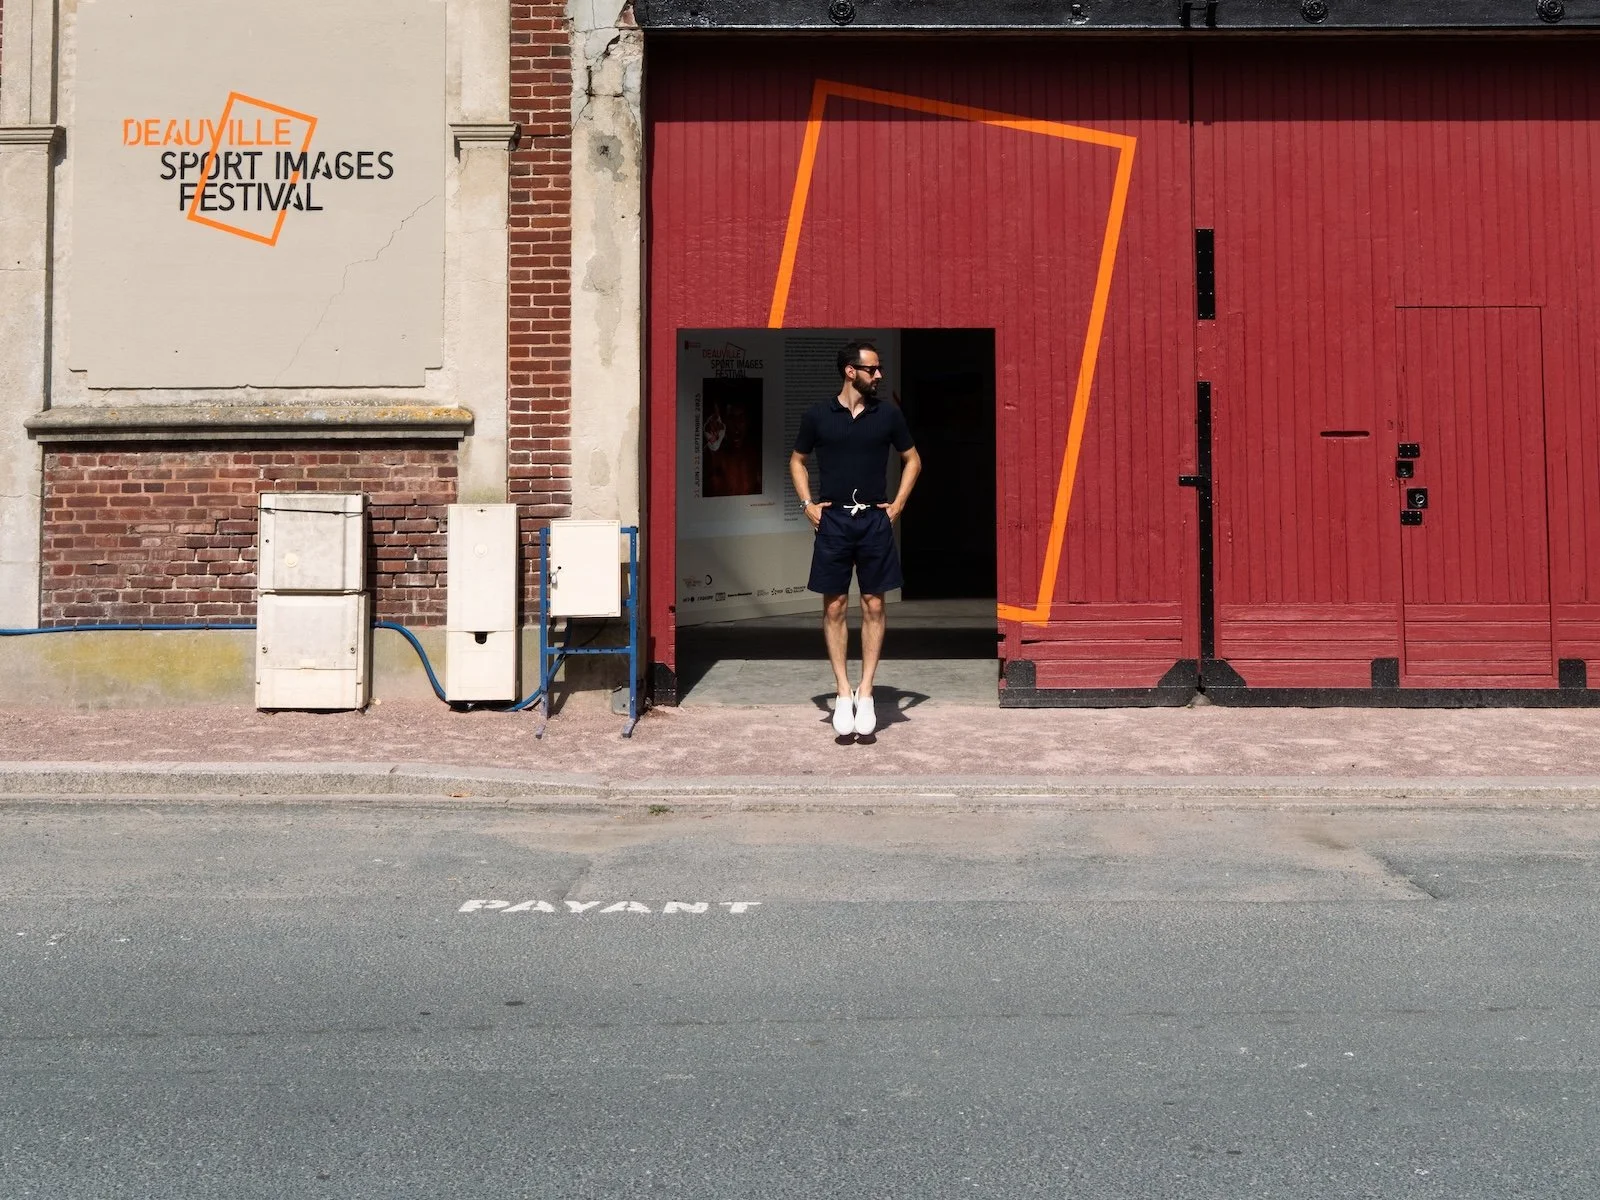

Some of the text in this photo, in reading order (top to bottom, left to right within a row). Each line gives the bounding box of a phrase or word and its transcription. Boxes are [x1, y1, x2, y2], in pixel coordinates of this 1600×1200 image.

[123, 119, 292, 146] DEAUVILLE
[160, 151, 394, 180] SPORT IMAGES
[179, 183, 323, 211] FESTIVAL
[702, 349, 741, 358] DEAUVILLE
[711, 360, 763, 369] SPORT IMAGES
[715, 369, 746, 378] FESTIVAL
[459, 900, 763, 913] PAYANT
